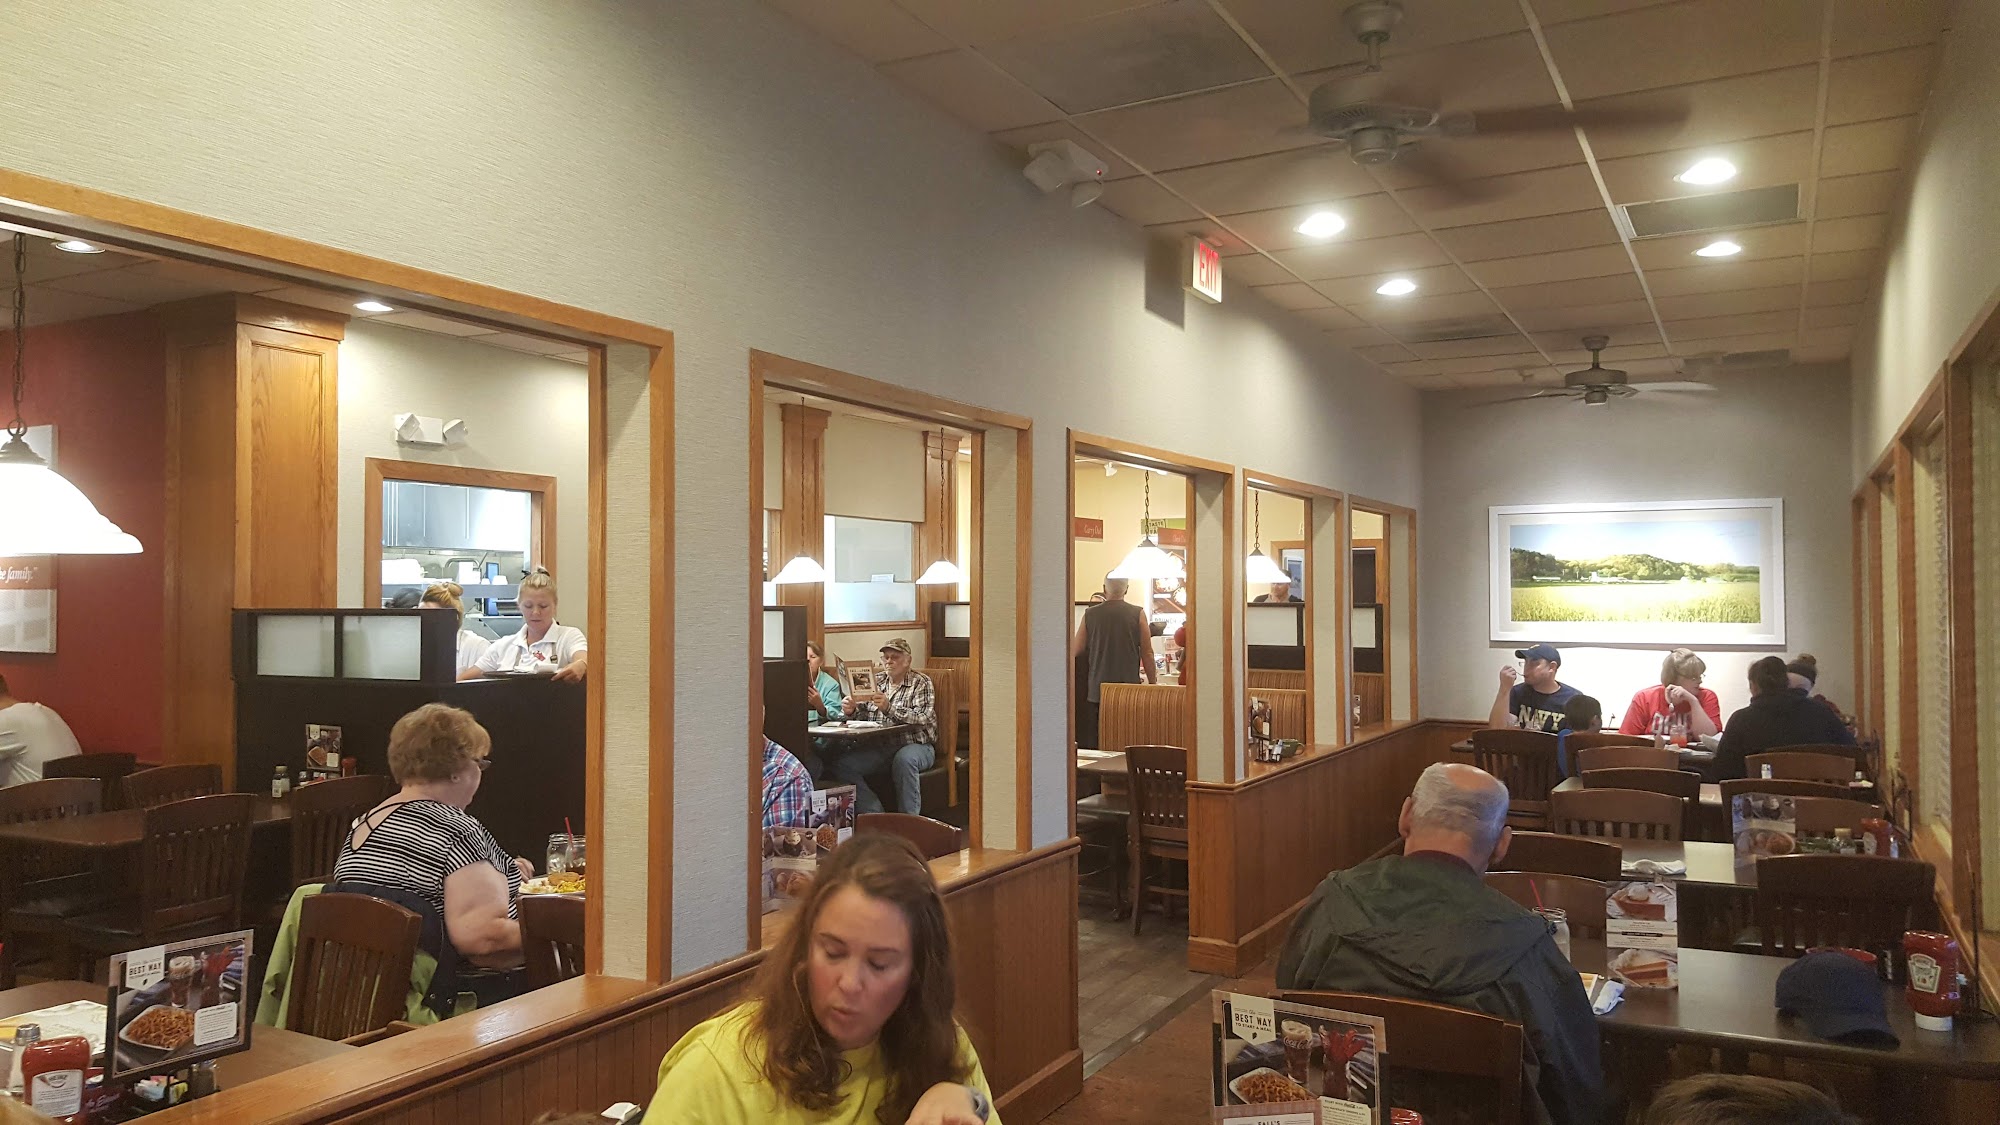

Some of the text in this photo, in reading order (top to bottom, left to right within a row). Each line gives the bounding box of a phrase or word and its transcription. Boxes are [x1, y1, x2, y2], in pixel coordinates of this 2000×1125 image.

[1199, 242, 1219, 294] EXIT
[1519, 704, 1566, 731] NAVY
[1234, 1013, 1272, 1027] BEST WAY
